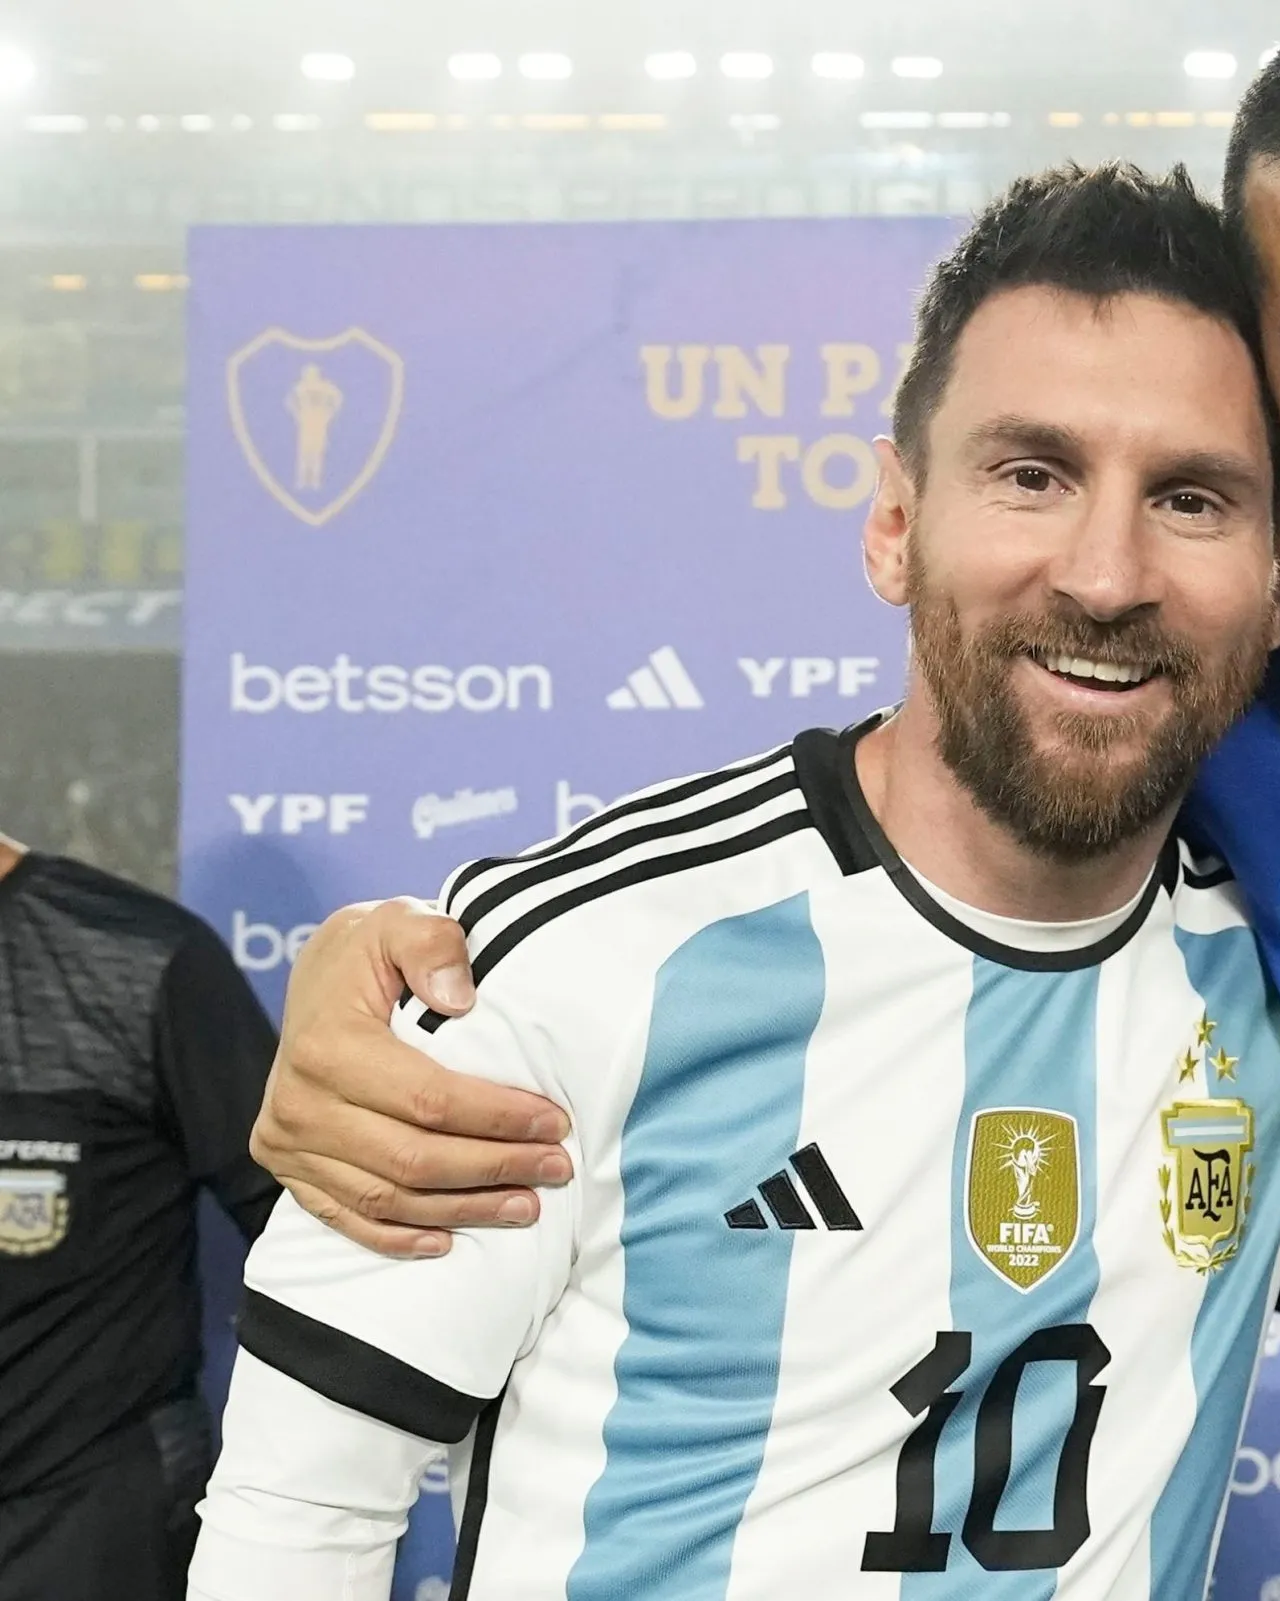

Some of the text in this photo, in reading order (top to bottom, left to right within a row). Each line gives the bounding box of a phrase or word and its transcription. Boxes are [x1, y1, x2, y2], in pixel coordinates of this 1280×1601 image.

[640, 343, 914, 420] UN P
[736, 433, 880, 509] TO
[230, 653, 552, 712] betsson
[738, 657, 880, 697] YPF
[228, 794, 369, 834] YPF
[1185, 1148, 1233, 1222] AFA
[1008, 1254, 1039, 1267] 2022
[861, 1323, 1112, 1572] 10
